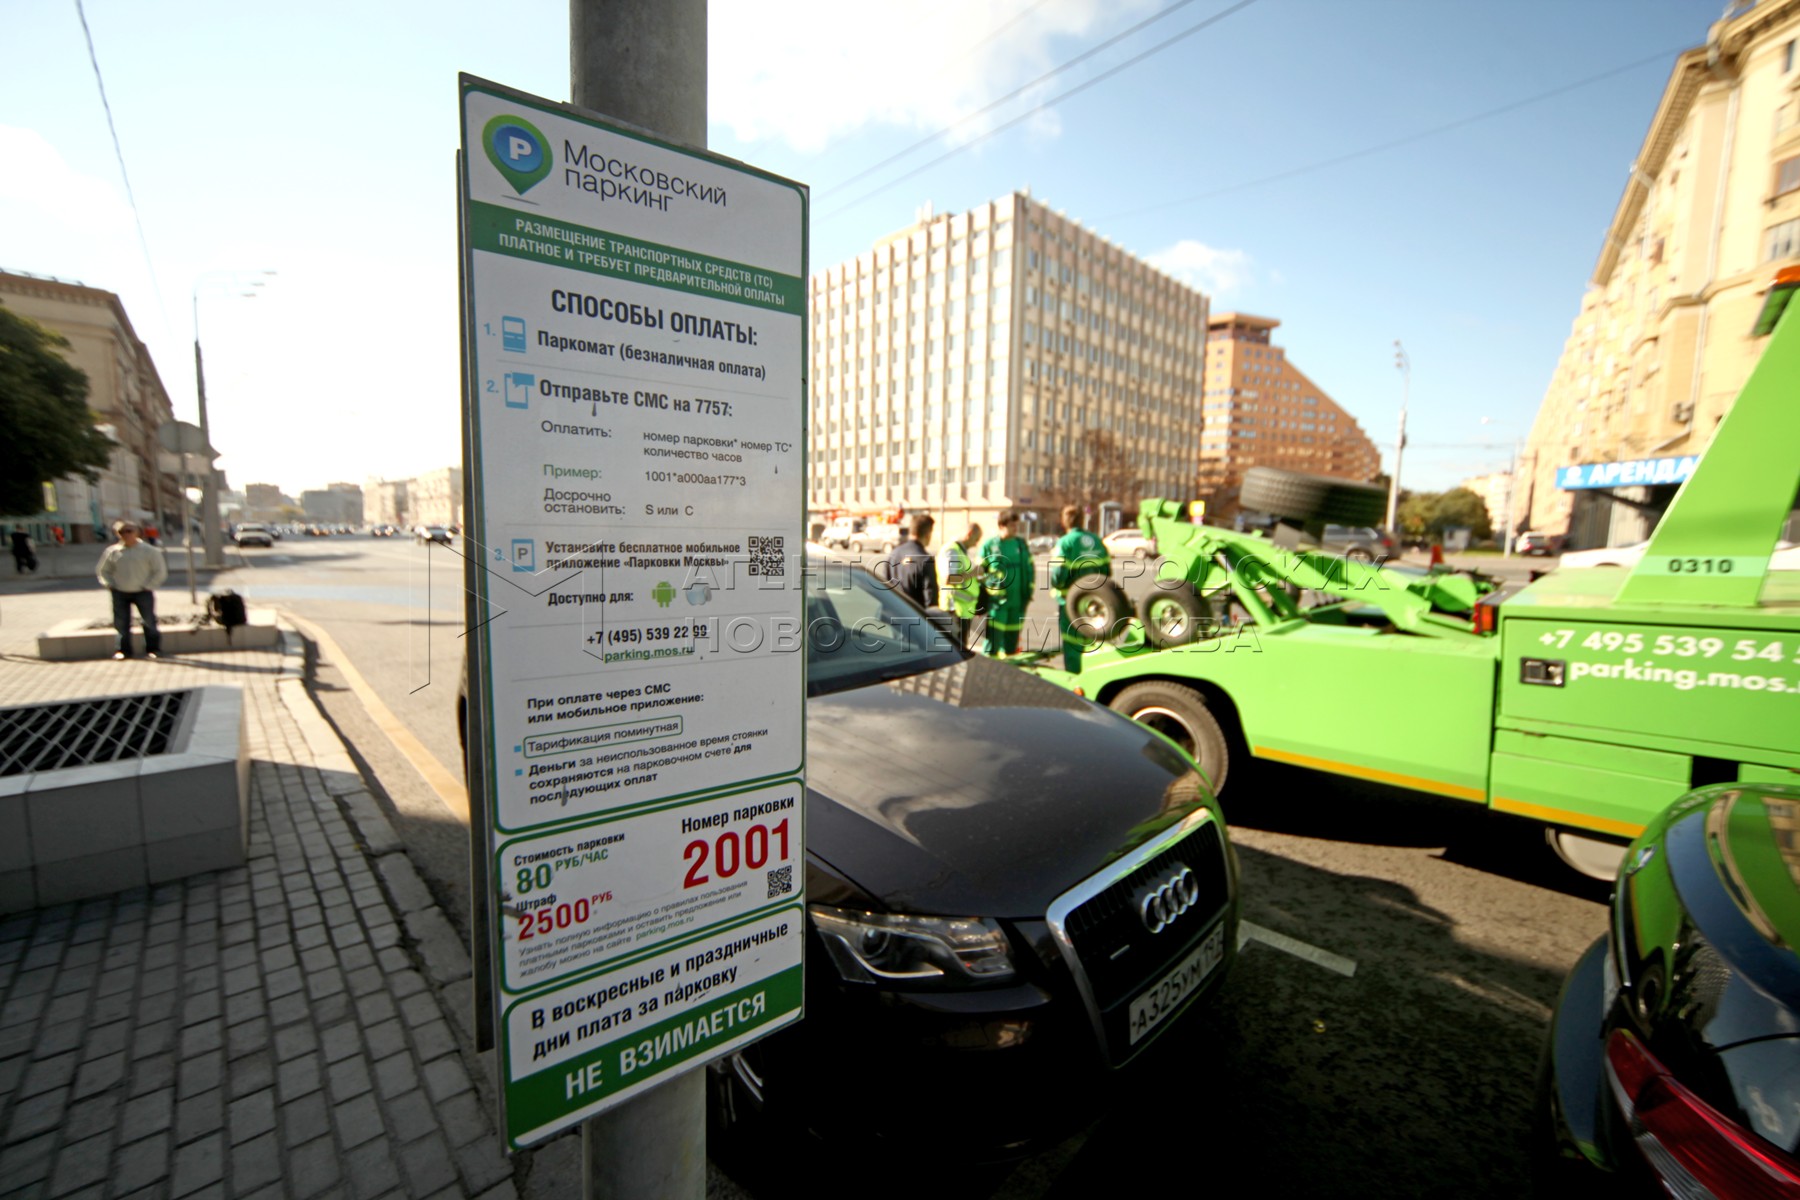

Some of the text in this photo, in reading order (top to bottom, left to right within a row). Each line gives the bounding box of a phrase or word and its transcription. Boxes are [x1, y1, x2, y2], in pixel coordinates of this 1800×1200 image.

[564, 139, 726, 207] Московский
[565, 169, 673, 212] паркинг
[499, 233, 785, 306] ПЛАТНОЕ И ТРЕБУЕТ ПРЕДВАРИТЕЛЬНОЙ ОПЛАТЫ
[515, 219, 773, 289] РАЗМЕЩЕНИЕ ТРАНСПОРТНЫХ СРЕДСТВ (ТС)
[551, 289, 757, 346] СПОСОБЫ ОПЛАТЫ:
[538, 330, 766, 383] Паркомат (безналичная оплата)
[539, 379, 733, 417] Отправьте СМС на 7757:
[541, 420, 613, 438] Оплатить:
[643, 432, 680, 446] номер
[741, 441, 772, 453] номер
[543, 464, 602, 480] Пример:
[643, 447, 743, 463] количество часов
[543, 488, 611, 504] Досрочно
[544, 502, 626, 515] остановить:
[645, 504, 654, 516] S
[657, 506, 679, 517] или
[545, 541, 741, 554] Установите бесплатное мобильное
[546, 556, 729, 570] приложение «Парковки Москвы»
[1668, 558, 1734, 574] 0310
[548, 592, 634, 607] Доступно для:
[587, 631, 604, 645] +7
[607, 629, 643, 646] (495)
[646, 627, 670, 641] 539
[673, 626, 689, 639] 22
[1539, 630, 1576, 649] +7
[1582, 631, 1644, 653] 495
[1652, 635, 1723, 657] 539
[1731, 639, 1785, 662] 54
[604, 645, 694, 664] parking.mos.ru
[527, 683, 672, 712] При оплате через СМС
[527, 693, 705, 724] или мобильное приложение:
[527, 722, 679, 754] Тарификация поминутная
[528, 727, 769, 778] Деньги за неиспользованное время стоянки
[529, 741, 752, 791] сохраняются на парковочном счете для
[529, 772, 658, 805] последующих оплат
[681, 796, 795, 835] Номер парковки
[513, 832, 625, 867] Стоимость парковки
[682, 817, 789, 890] 2001
[516, 848, 609, 896] 80 РУБ/ЧАС
[515, 894, 557, 914] Штраф
[517, 890, 613, 943] 2500 РУБ
[555, 929, 591, 947] полную
[592, 909, 652, 934] информацию
[661, 898, 699, 915] правилах
[700, 880, 748, 901] пользования
[571, 931, 626, 953] парковками
[627, 925, 634, 933] и
[635, 913, 673, 930] оставить
[674, 896, 727, 919] предложение
[728, 890, 742, 901] или
[559, 950, 591, 965] можно
[606, 936, 632, 950] сайте
[531, 922, 789, 1030] В воскресные и праздничные
[532, 965, 738, 1062] дни плата за парковку
[565, 991, 766, 1101] НЕ ВЗИМАЕТСЯ
